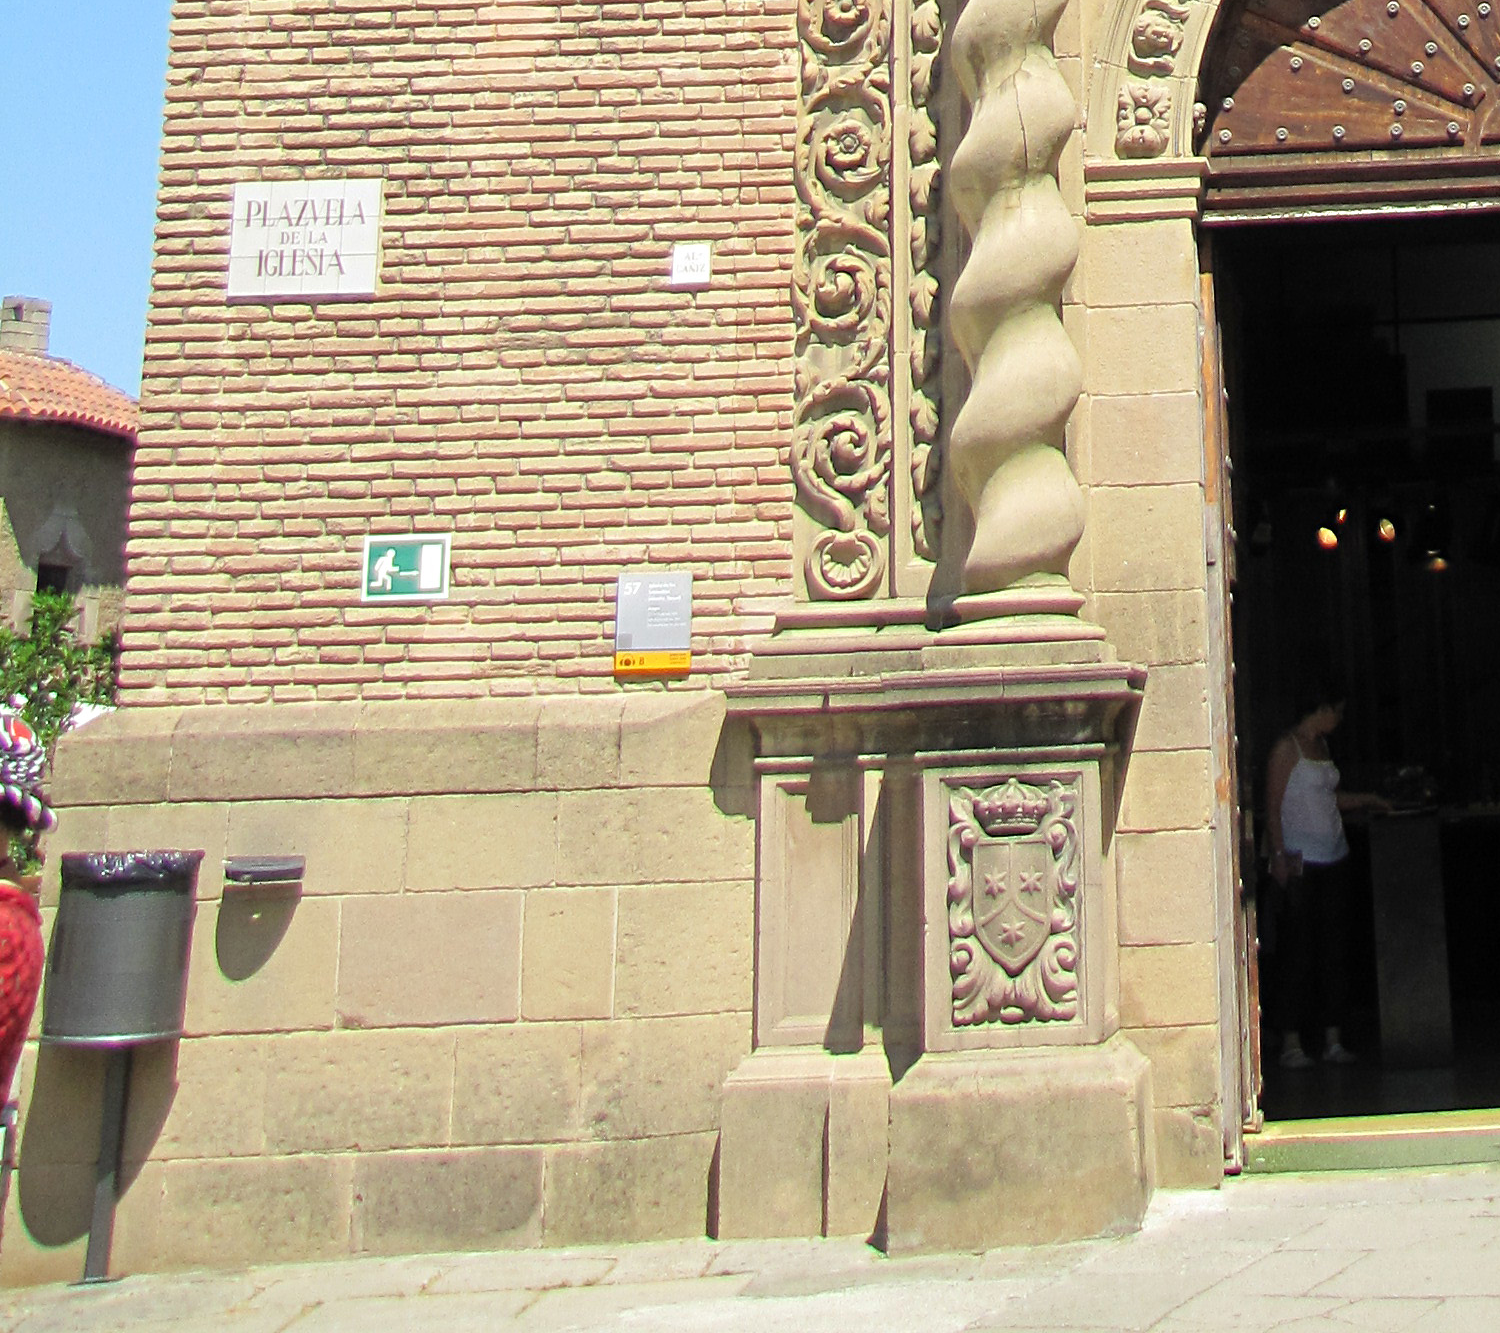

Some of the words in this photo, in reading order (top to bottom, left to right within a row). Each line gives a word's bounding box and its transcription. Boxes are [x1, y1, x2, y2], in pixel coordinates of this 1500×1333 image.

[280, 231, 301, 245] DE
[308, 230, 329, 244] LA
[257, 247, 346, 278] IGLESIA
[623, 581, 642, 596] 57
